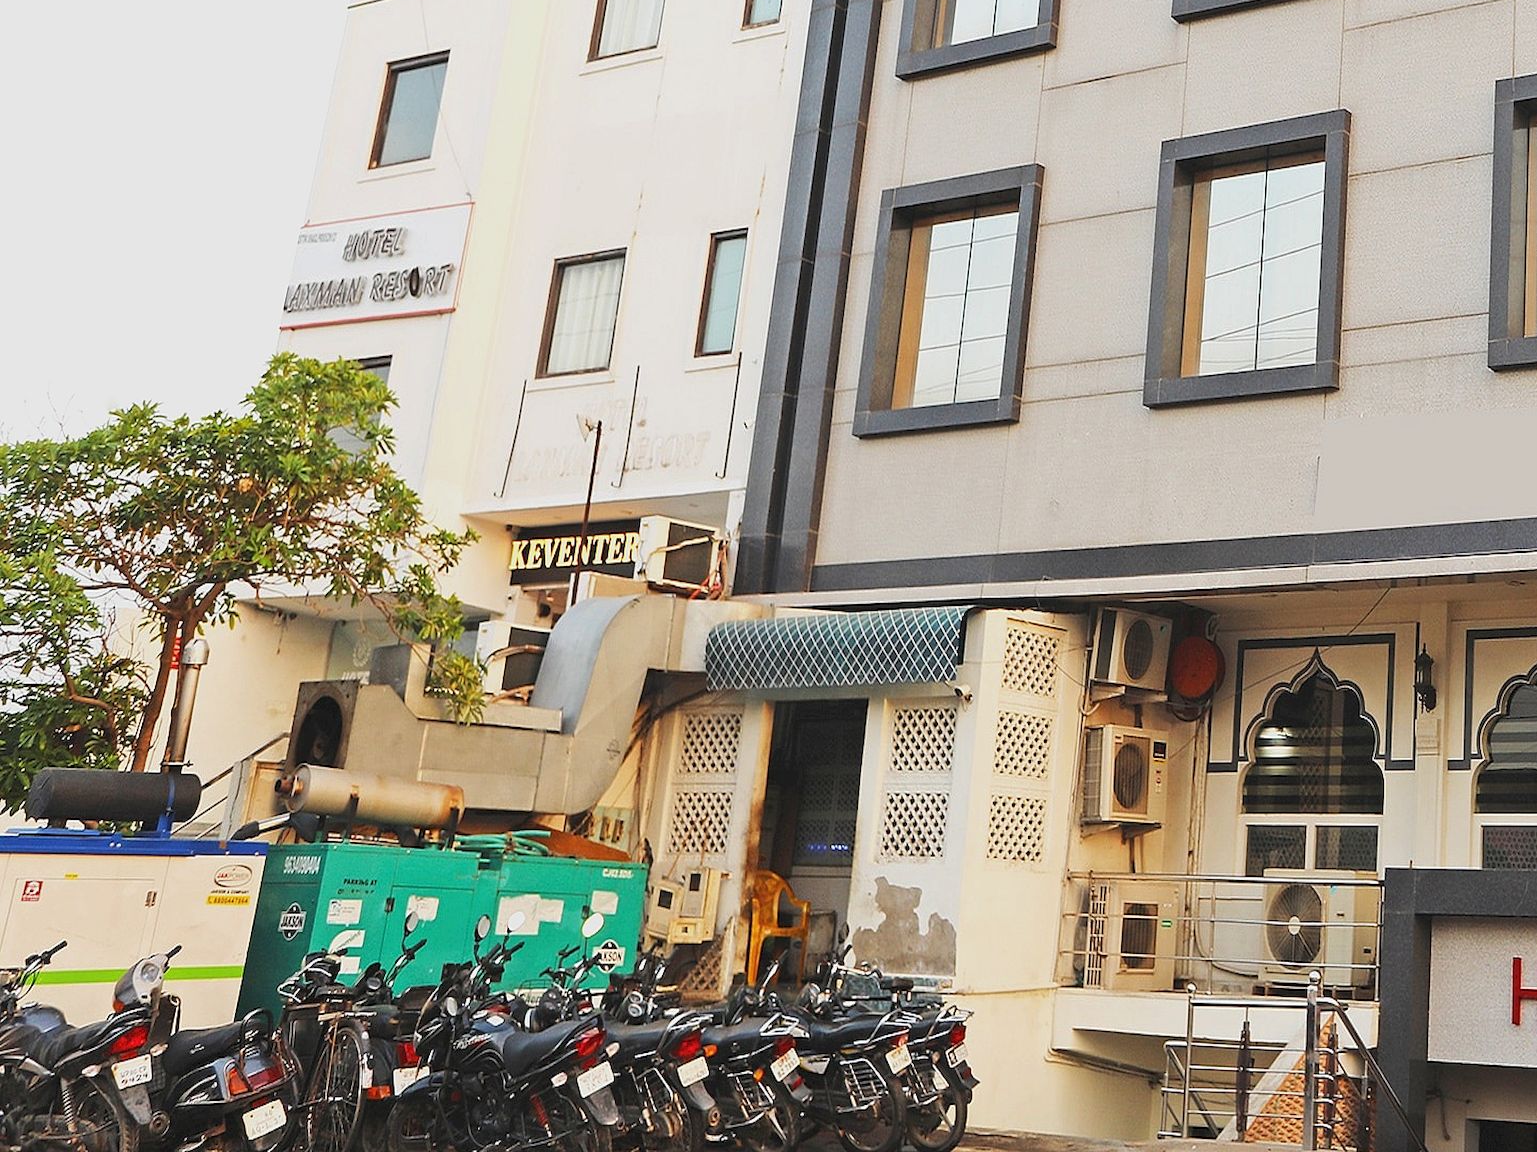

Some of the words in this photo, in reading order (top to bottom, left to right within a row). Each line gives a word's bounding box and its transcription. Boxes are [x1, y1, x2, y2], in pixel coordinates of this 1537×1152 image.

[343, 227, 408, 262] HOTEL
[369, 263, 456, 303] RESORT
[509, 531, 640, 570] KEVENTER
[343, 878, 368, 886] PARKING
